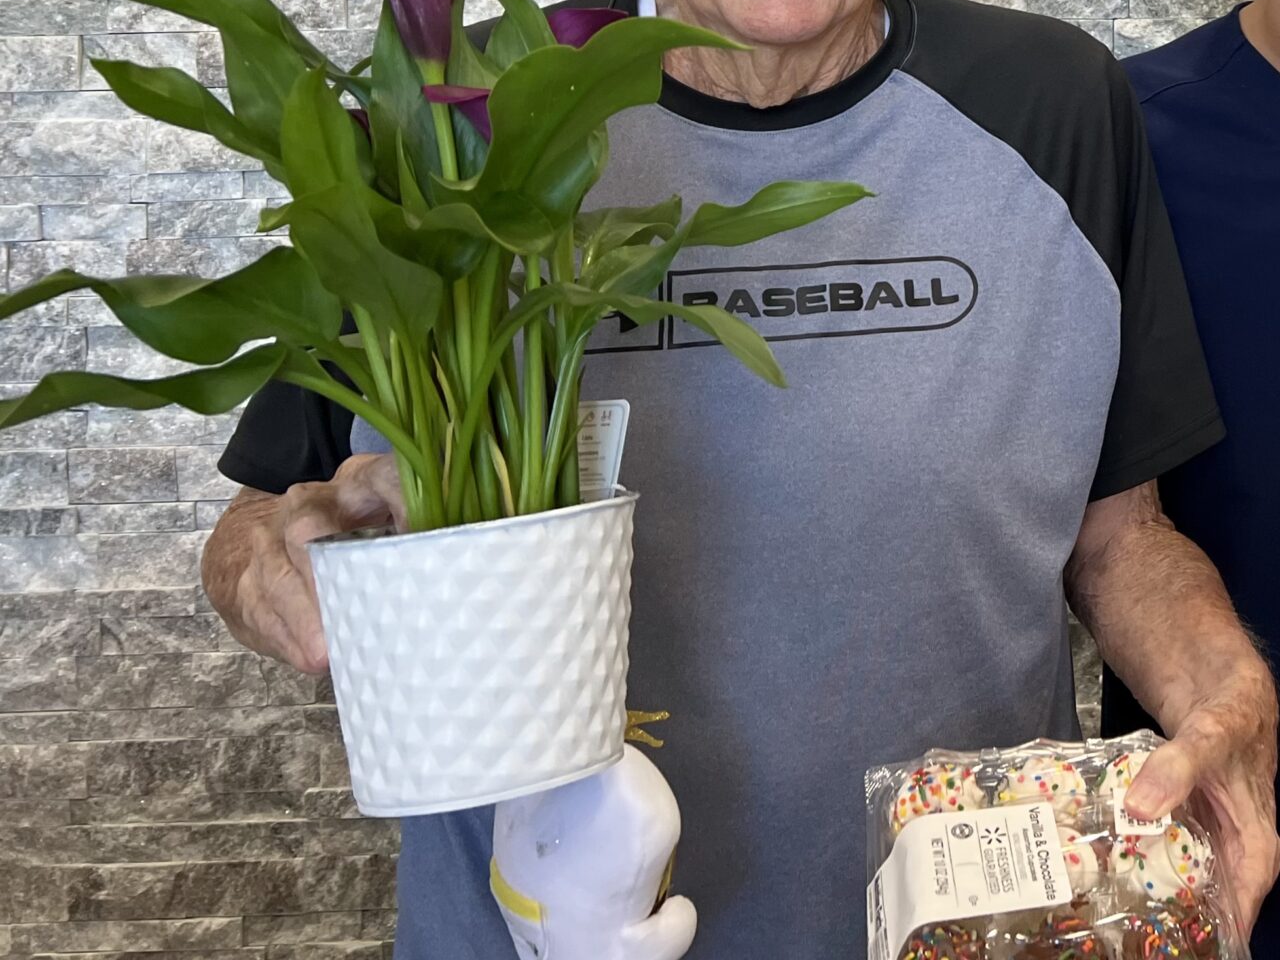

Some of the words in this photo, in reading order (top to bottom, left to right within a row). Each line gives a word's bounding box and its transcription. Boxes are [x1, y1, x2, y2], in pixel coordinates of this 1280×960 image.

[1029, 806, 1043, 838] Vanilla
[1035, 840, 1047, 848] &
[996, 847, 1015, 893] FRESHNESS
[1037, 849, 1056, 901] Chocolate
